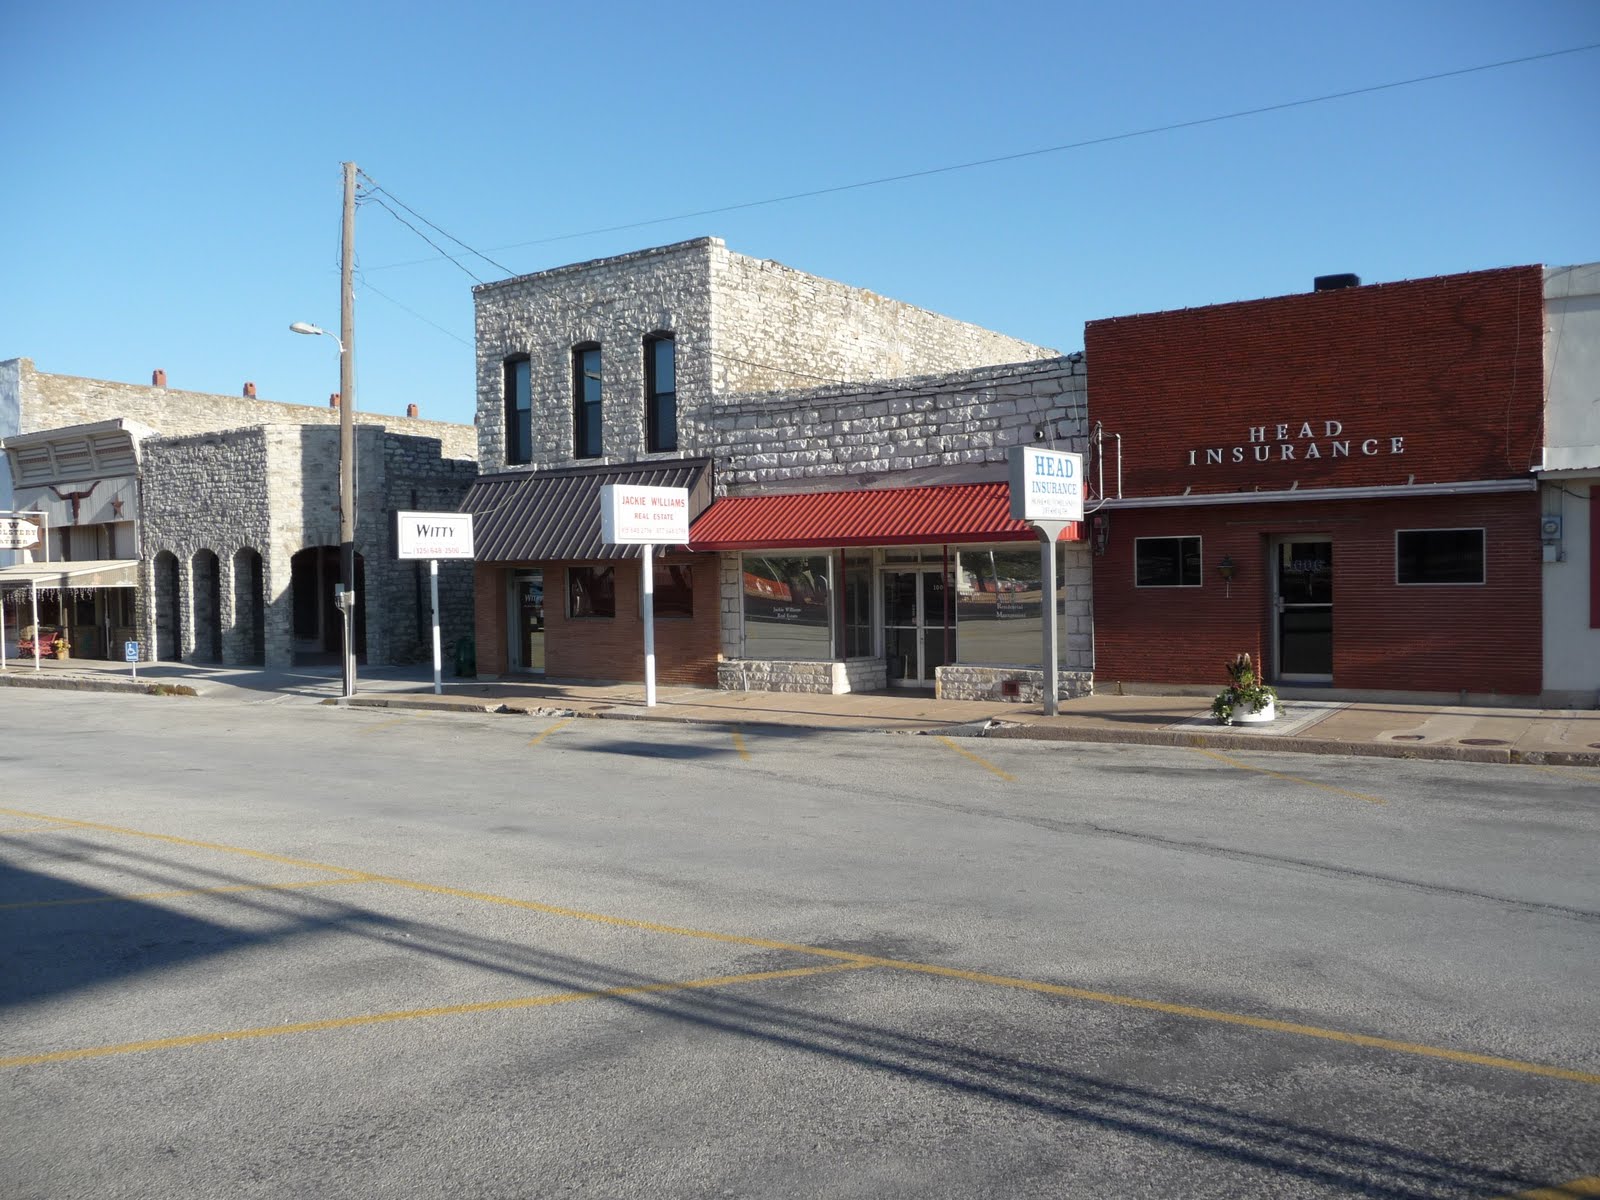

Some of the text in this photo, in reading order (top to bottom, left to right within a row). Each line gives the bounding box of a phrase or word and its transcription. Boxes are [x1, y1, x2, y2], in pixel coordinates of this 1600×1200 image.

[1249, 420, 1343, 443] HEAD
[1188, 436, 1405, 466] INSURANCE
[1035, 455, 1074, 478] HEAD
[1032, 481, 1077, 495] INSURANCE
[622, 496, 685, 508] JACKIE WILLIAMS
[634, 512, 674, 521] REAL ESTATE
